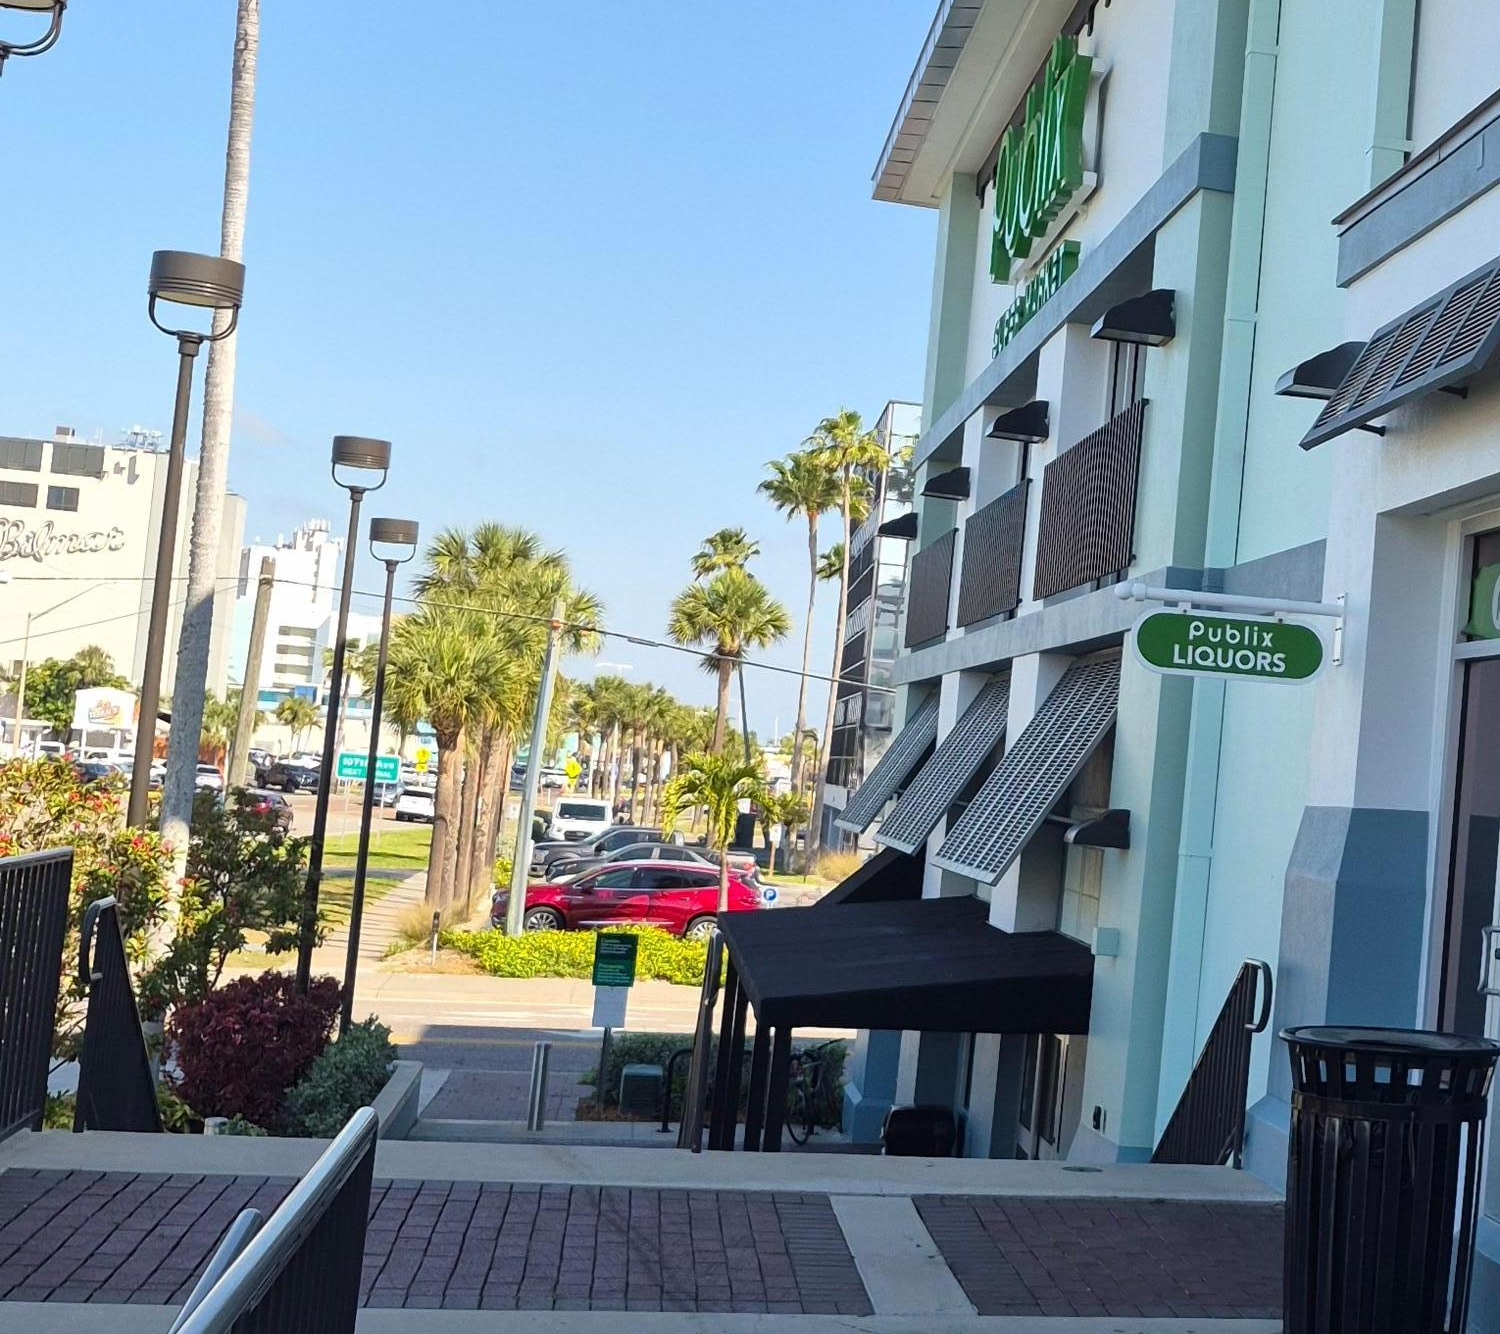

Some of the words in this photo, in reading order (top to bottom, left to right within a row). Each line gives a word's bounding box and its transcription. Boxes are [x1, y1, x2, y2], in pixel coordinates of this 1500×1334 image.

[1189, 621, 1273, 647] Publix
[1173, 644, 1286, 673] LIQUORS
[342, 757, 369, 767] 107t
